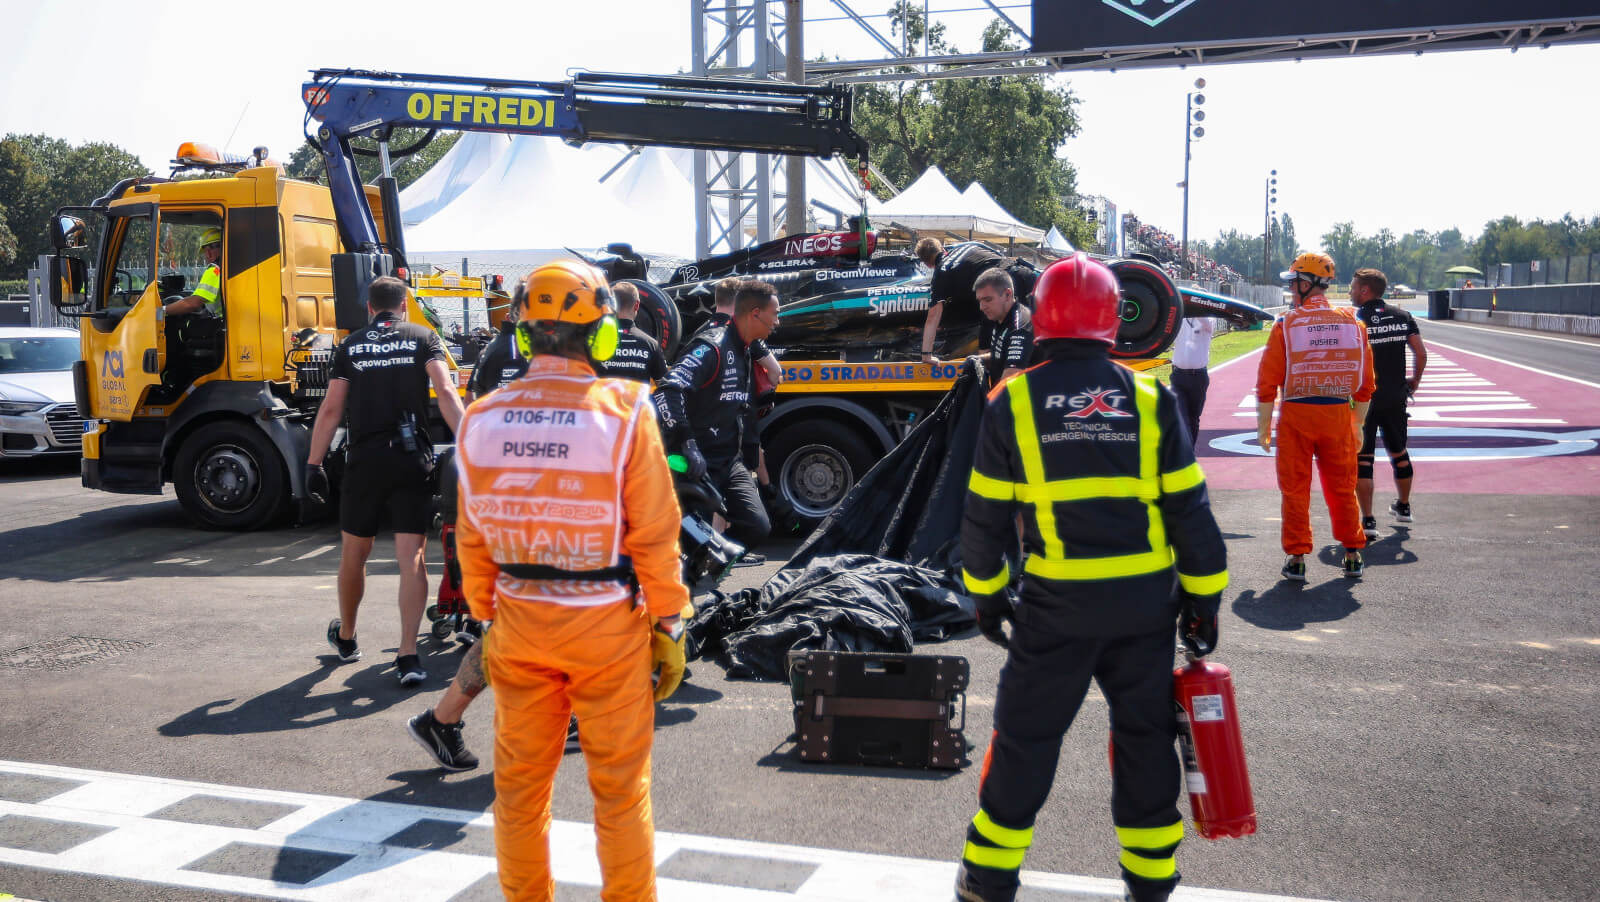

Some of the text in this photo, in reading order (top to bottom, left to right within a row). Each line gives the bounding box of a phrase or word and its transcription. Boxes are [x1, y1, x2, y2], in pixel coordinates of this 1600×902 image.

[407, 92, 555, 127] OFFREDI
[784, 235, 843, 256] INEOS
[768, 259, 808, 269] SOLERA
[678, 265, 699, 284] 12
[830, 267, 897, 280] TeamViewer
[867, 286, 930, 297] PETRONAS
[868, 296, 930, 317] Syntium
[1366, 323, 1408, 334] ETRONAS
[348, 340, 417, 356] PETRONAS
[1310, 338, 1339, 346] PUSHER
[615, 348, 649, 359] RONAS
[357, 356, 415, 368] CROWDSTRIKE
[820, 365, 914, 381] STRADALE
[102, 380, 127, 391] GLOBAL
[1293, 374, 1353, 387] PITLANE
[654, 391, 678, 428] INEOS
[503, 410, 577, 425] 0106-ITA
[1098, 433, 1137, 441] RESCUE
[503, 441, 569, 459] PUSHER
[558, 477, 583, 491] FIA
[481, 523, 604, 557] PITLANE
